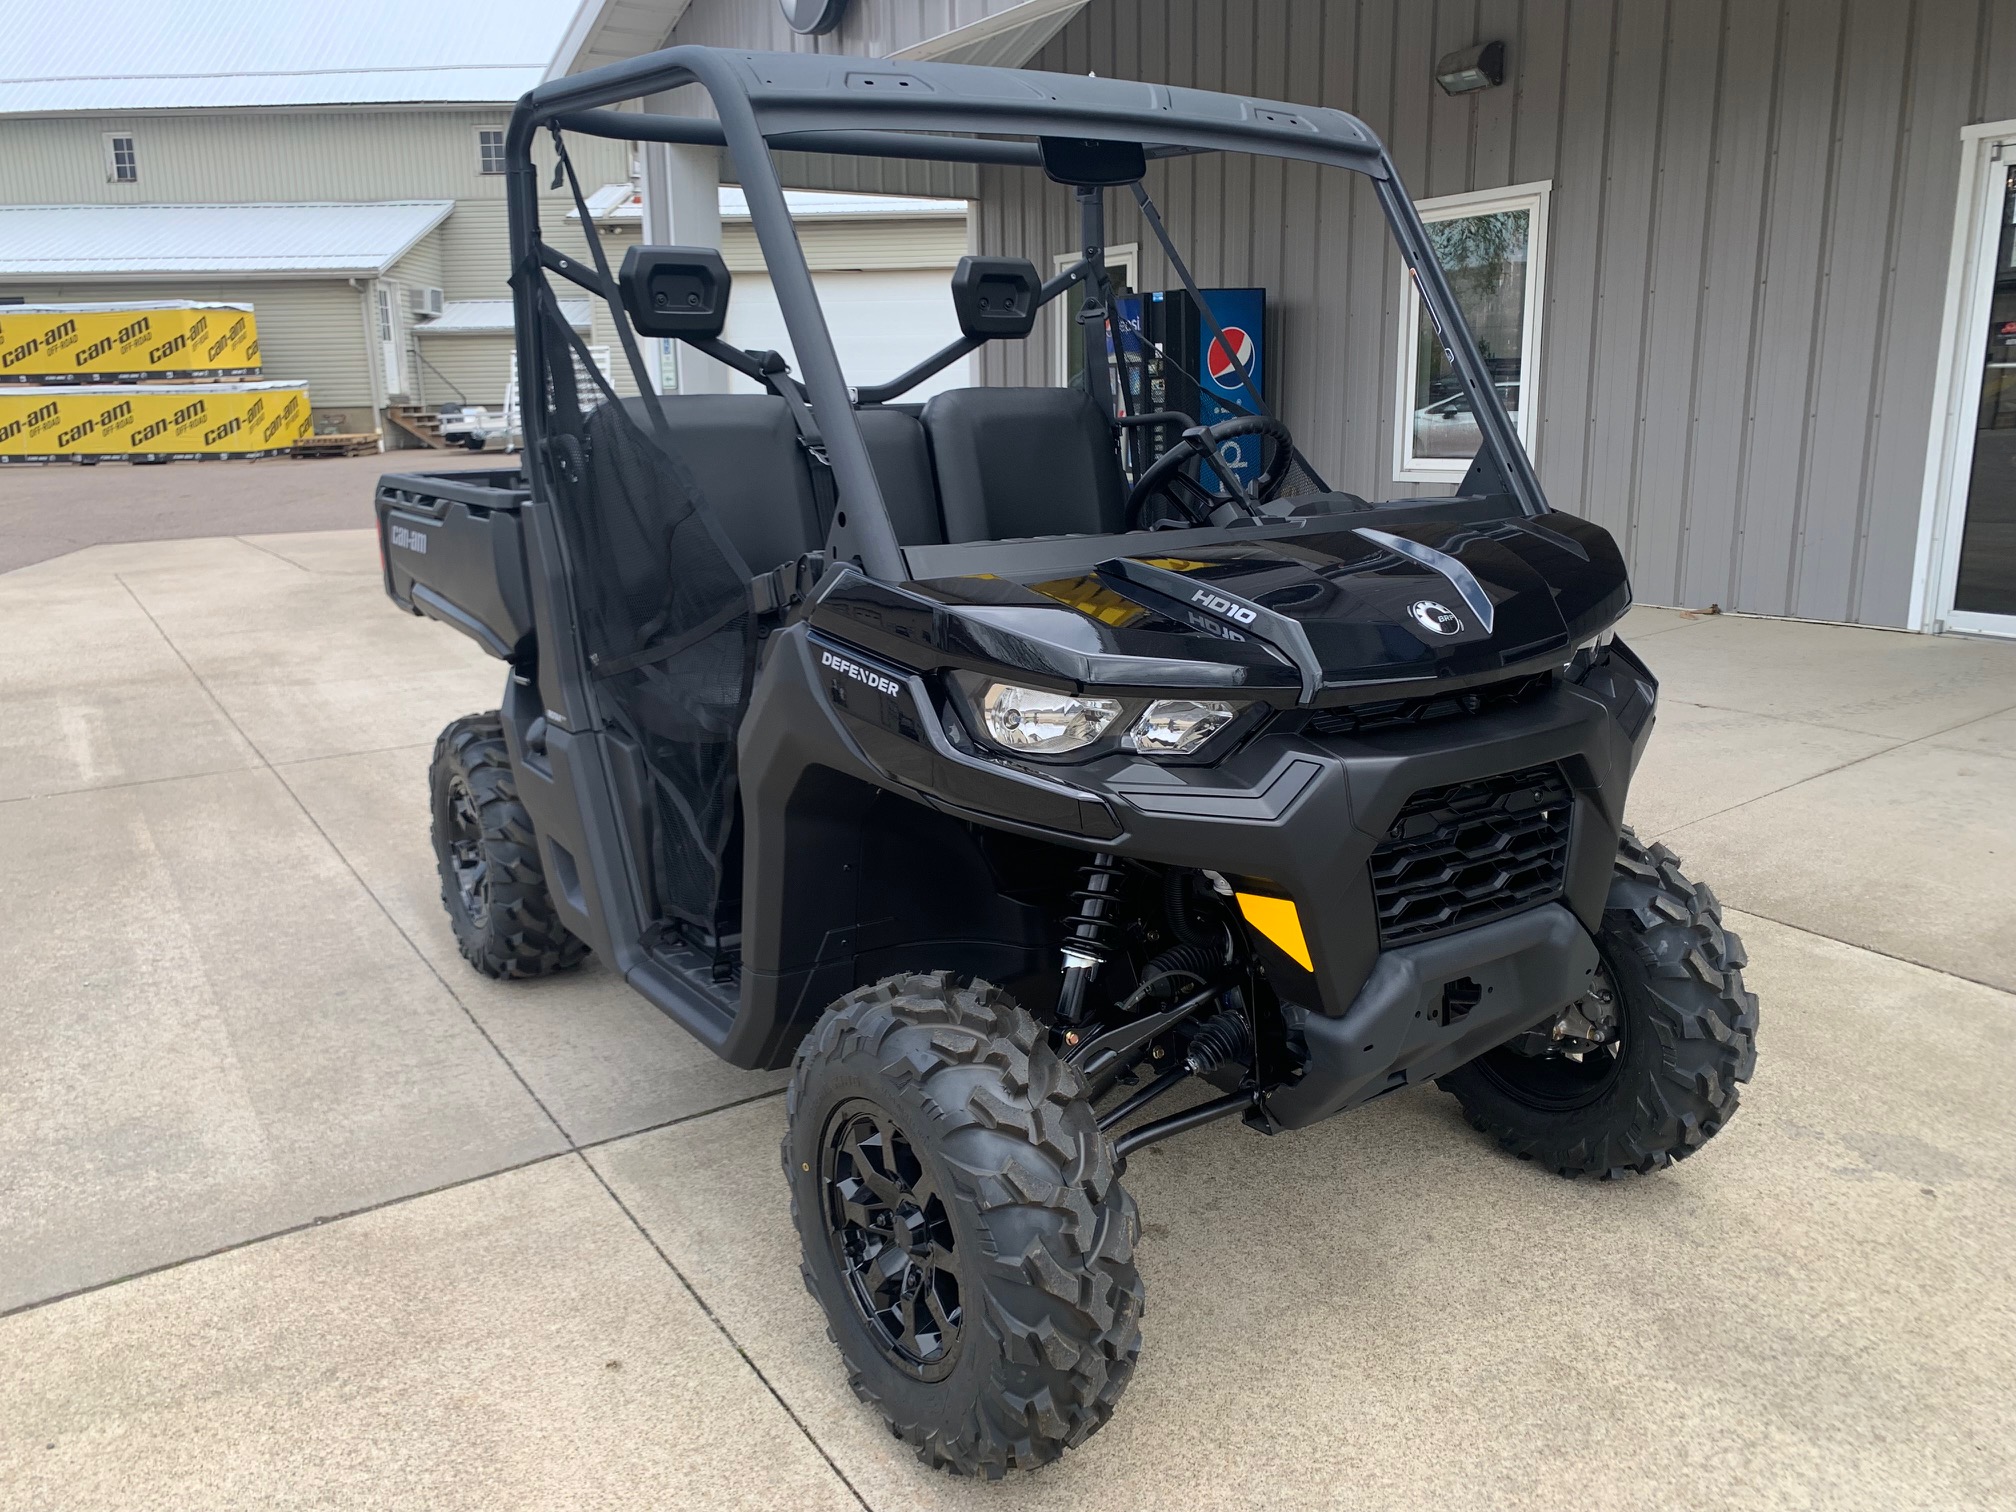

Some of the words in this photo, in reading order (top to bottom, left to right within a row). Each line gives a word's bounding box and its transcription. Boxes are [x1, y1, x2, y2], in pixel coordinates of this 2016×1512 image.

[2, 319, 76, 368] can-am
[75, 316, 150, 367] can-am
[149, 315, 207, 365] can-am
[0, 401, 59, 442] an-am
[57, 400, 132, 448] can-am
[130, 399, 205, 447] can-am
[204, 397, 264, 446] can-am
[392, 525, 427, 554] can-am
[1191, 589, 1257, 624] HD10
[1437, 614, 1455, 623] BRP
[821, 651, 900, 697] DEFENDER
